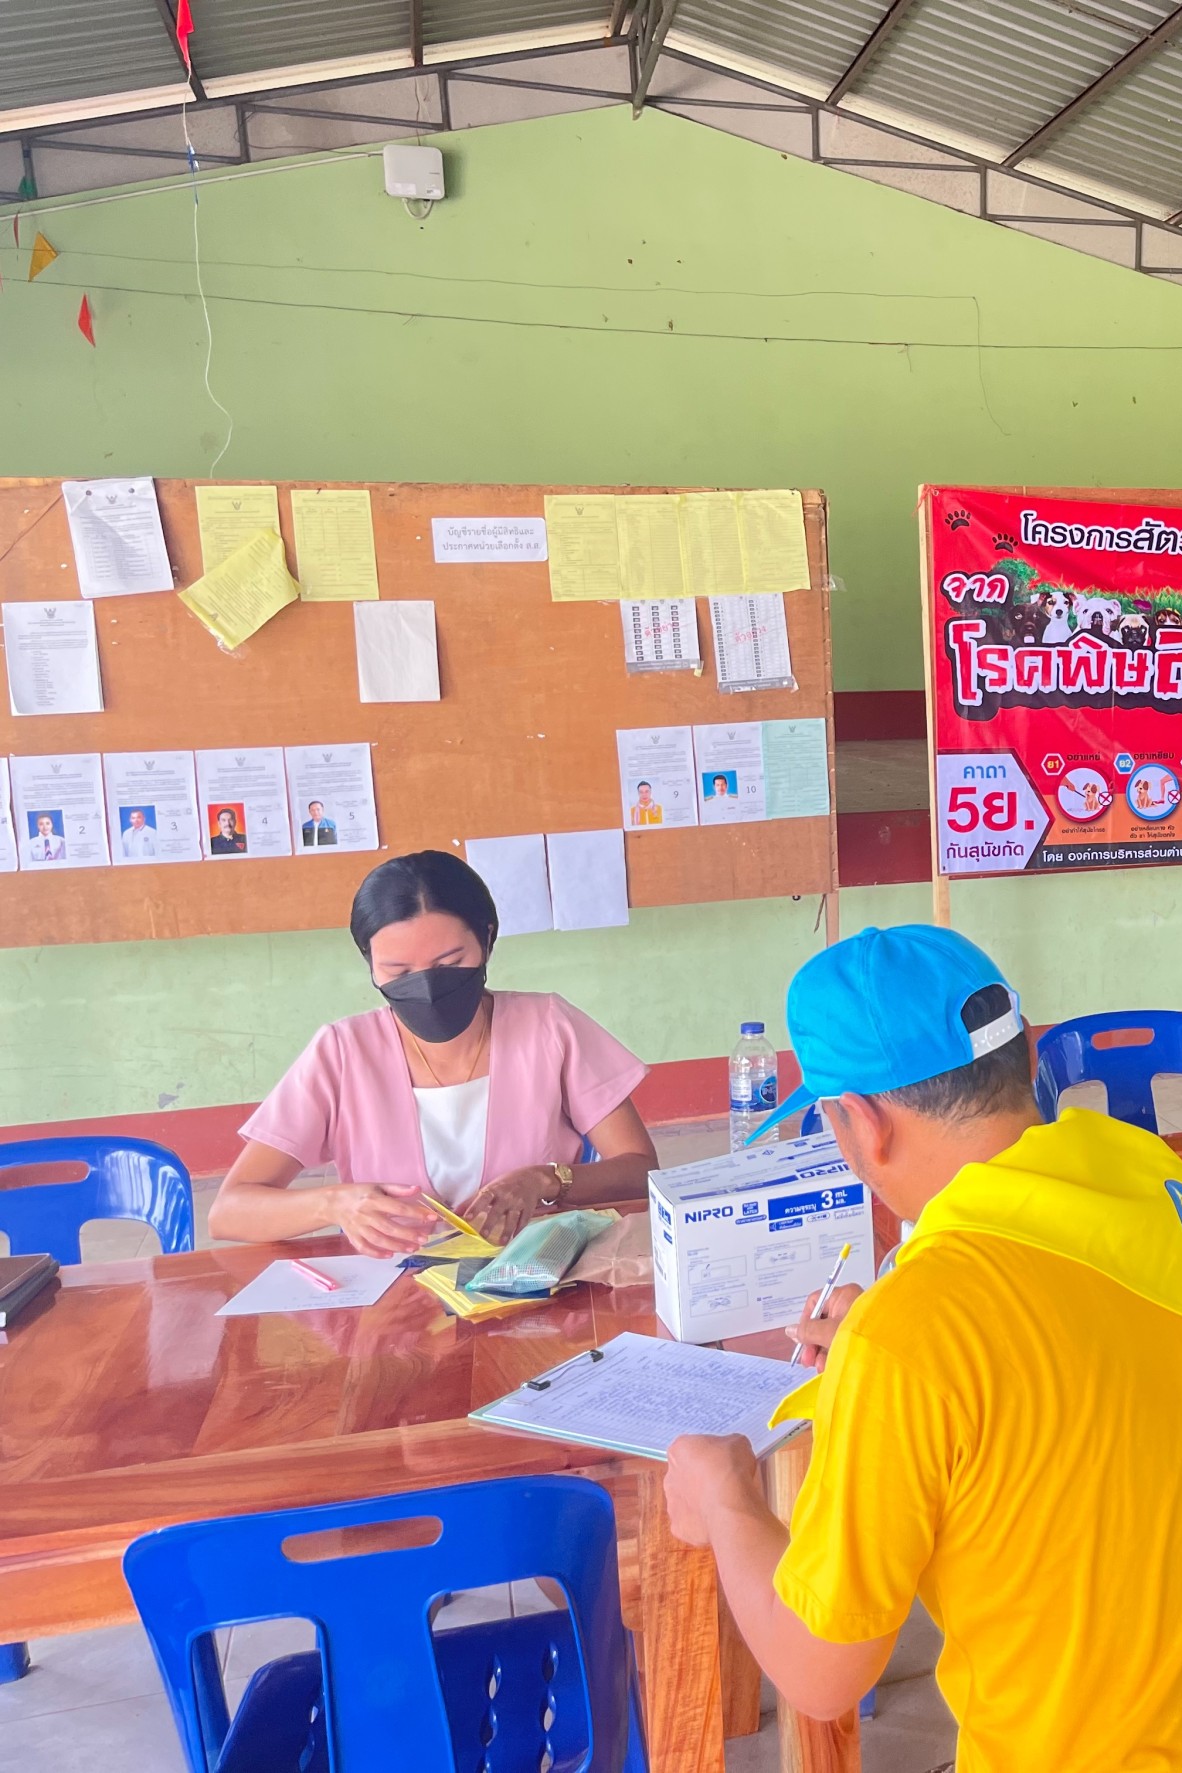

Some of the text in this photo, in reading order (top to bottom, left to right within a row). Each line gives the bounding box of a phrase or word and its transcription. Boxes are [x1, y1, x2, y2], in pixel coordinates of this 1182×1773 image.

[943, 573, 1009, 603] จาก
[746, 785, 757, 794] 10
[947, 786, 1035, 833] 5ย.
[946, 840, 1024, 863] กันสุนัขกัด
[1043, 850, 1063, 863] โดย
[821, 1190, 834, 1209] 3
[835, 1189, 848, 1198] mL
[684, 1205, 734, 1224] NIPRO
